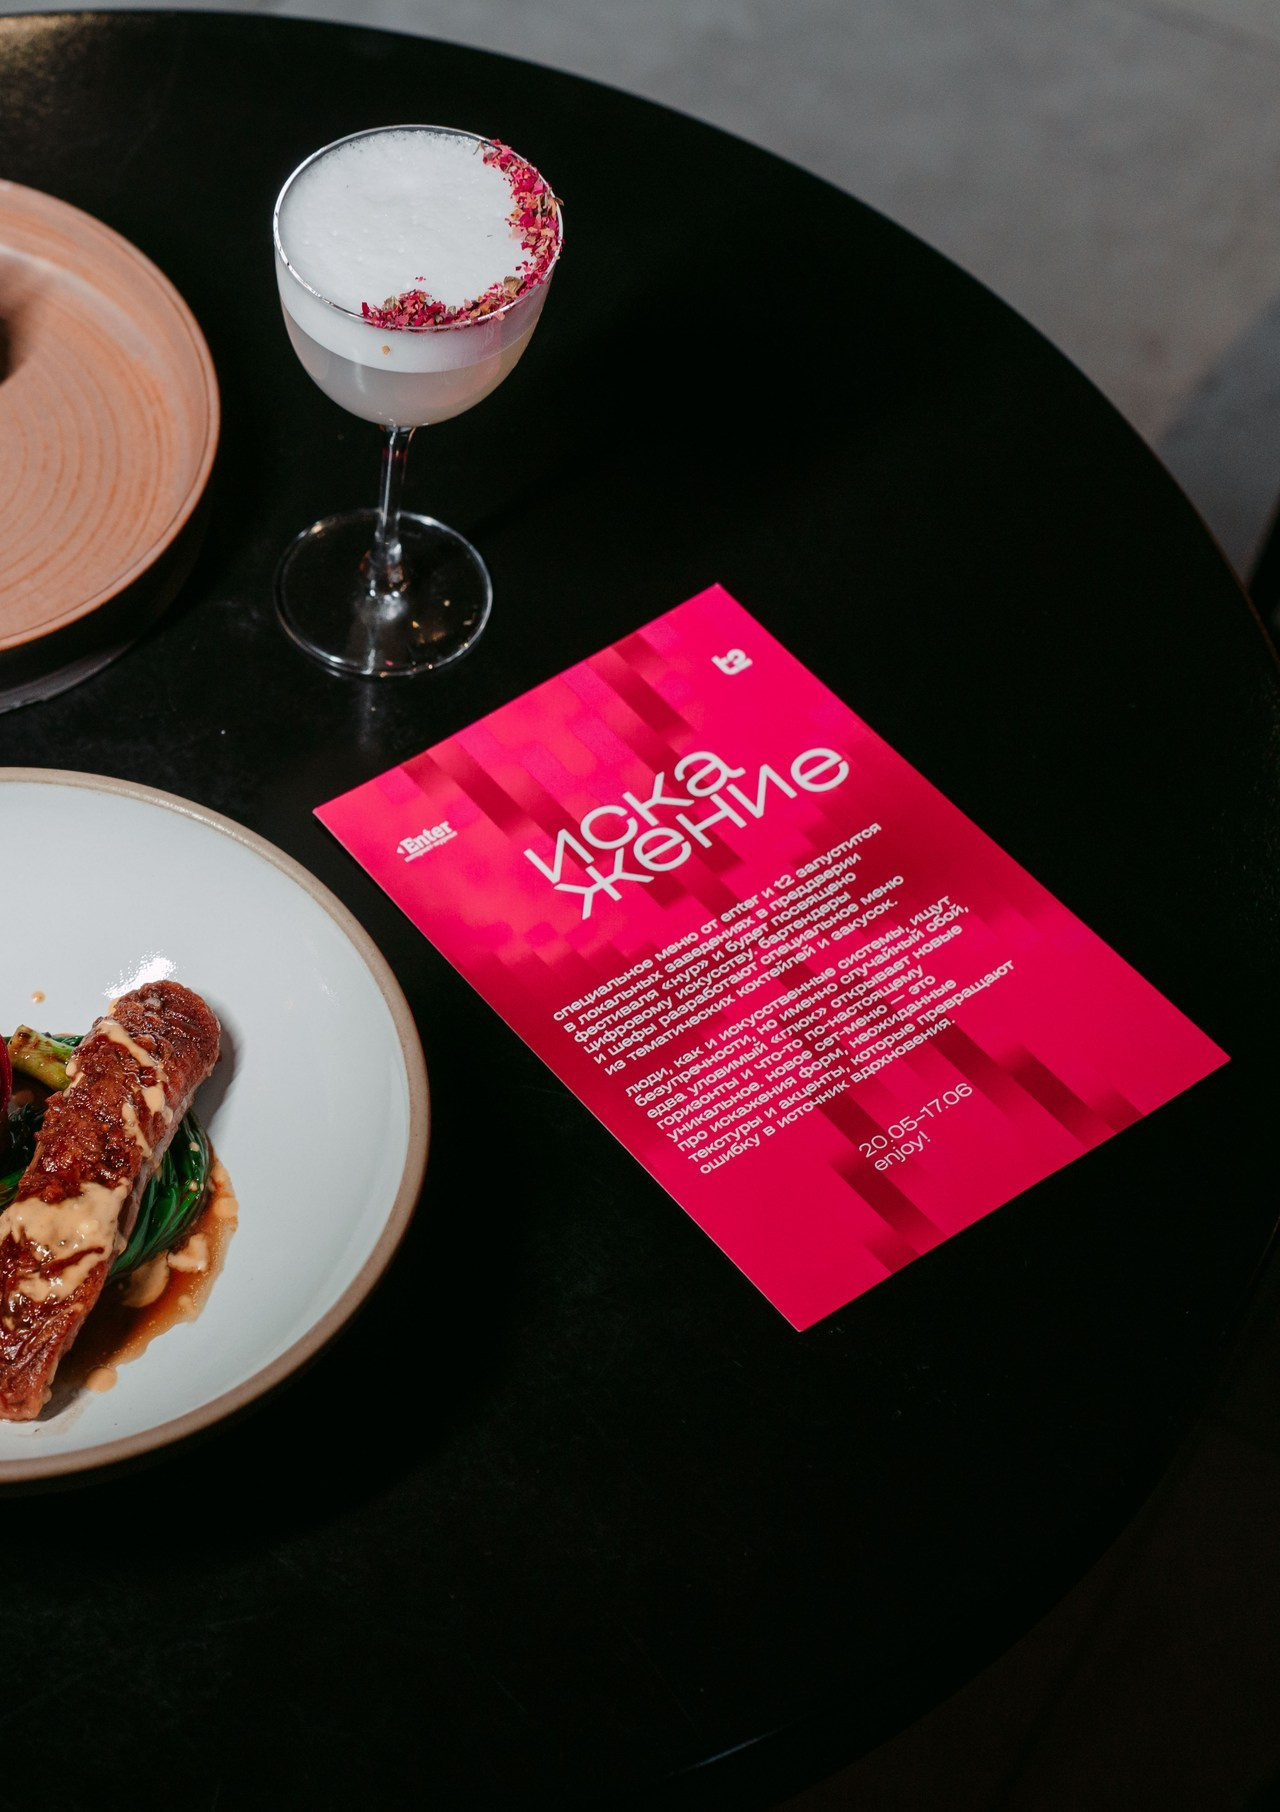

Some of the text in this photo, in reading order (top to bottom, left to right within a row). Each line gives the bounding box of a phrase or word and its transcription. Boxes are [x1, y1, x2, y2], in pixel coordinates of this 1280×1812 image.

[711, 648, 753, 676] t2
[399, 821, 453, 854] Enter
[523, 751, 746, 884] иска
[553, 747, 849, 920] жение
[553, 822, 882, 1022] специальное меню от enter и t2 запустится
[563, 852, 862, 1033] в локальных заведениях в преддверии
[573, 872, 857, 1043] фестиваля «нур» и будет посвящено
[583, 891, 852, 1054] цифровому искусству. бартендеры
[593, 875, 905, 1065] и шефы разработают специальное меню
[604, 898, 898, 1076] из тематических коктейлей и закусок.
[625, 895, 951, 1098] люди, как и искусственные системы, ищут
[634, 903, 969, 1107] безупречности, но именно случайный сбой,
[646, 924, 963, 1119] едва уловимый «глюк» открывает новые
[656, 964, 924, 1130] горизонты и что-то по-настоящему
[666, 1081, 765, 1143] уникальное.
[764, 1049, 813, 1083] новое
[814, 1004, 888, 1052] сет-меню
[908, 975, 936, 995] это
[676, 979, 957, 1152] про искажения форм, неожиданные
[687, 959, 1014, 1163] текстуры и акценты, которые превращают
[699, 1017, 956, 1174] ошибку в источник вдохновения.
[874, 1130, 931, 1171] enjoy!
